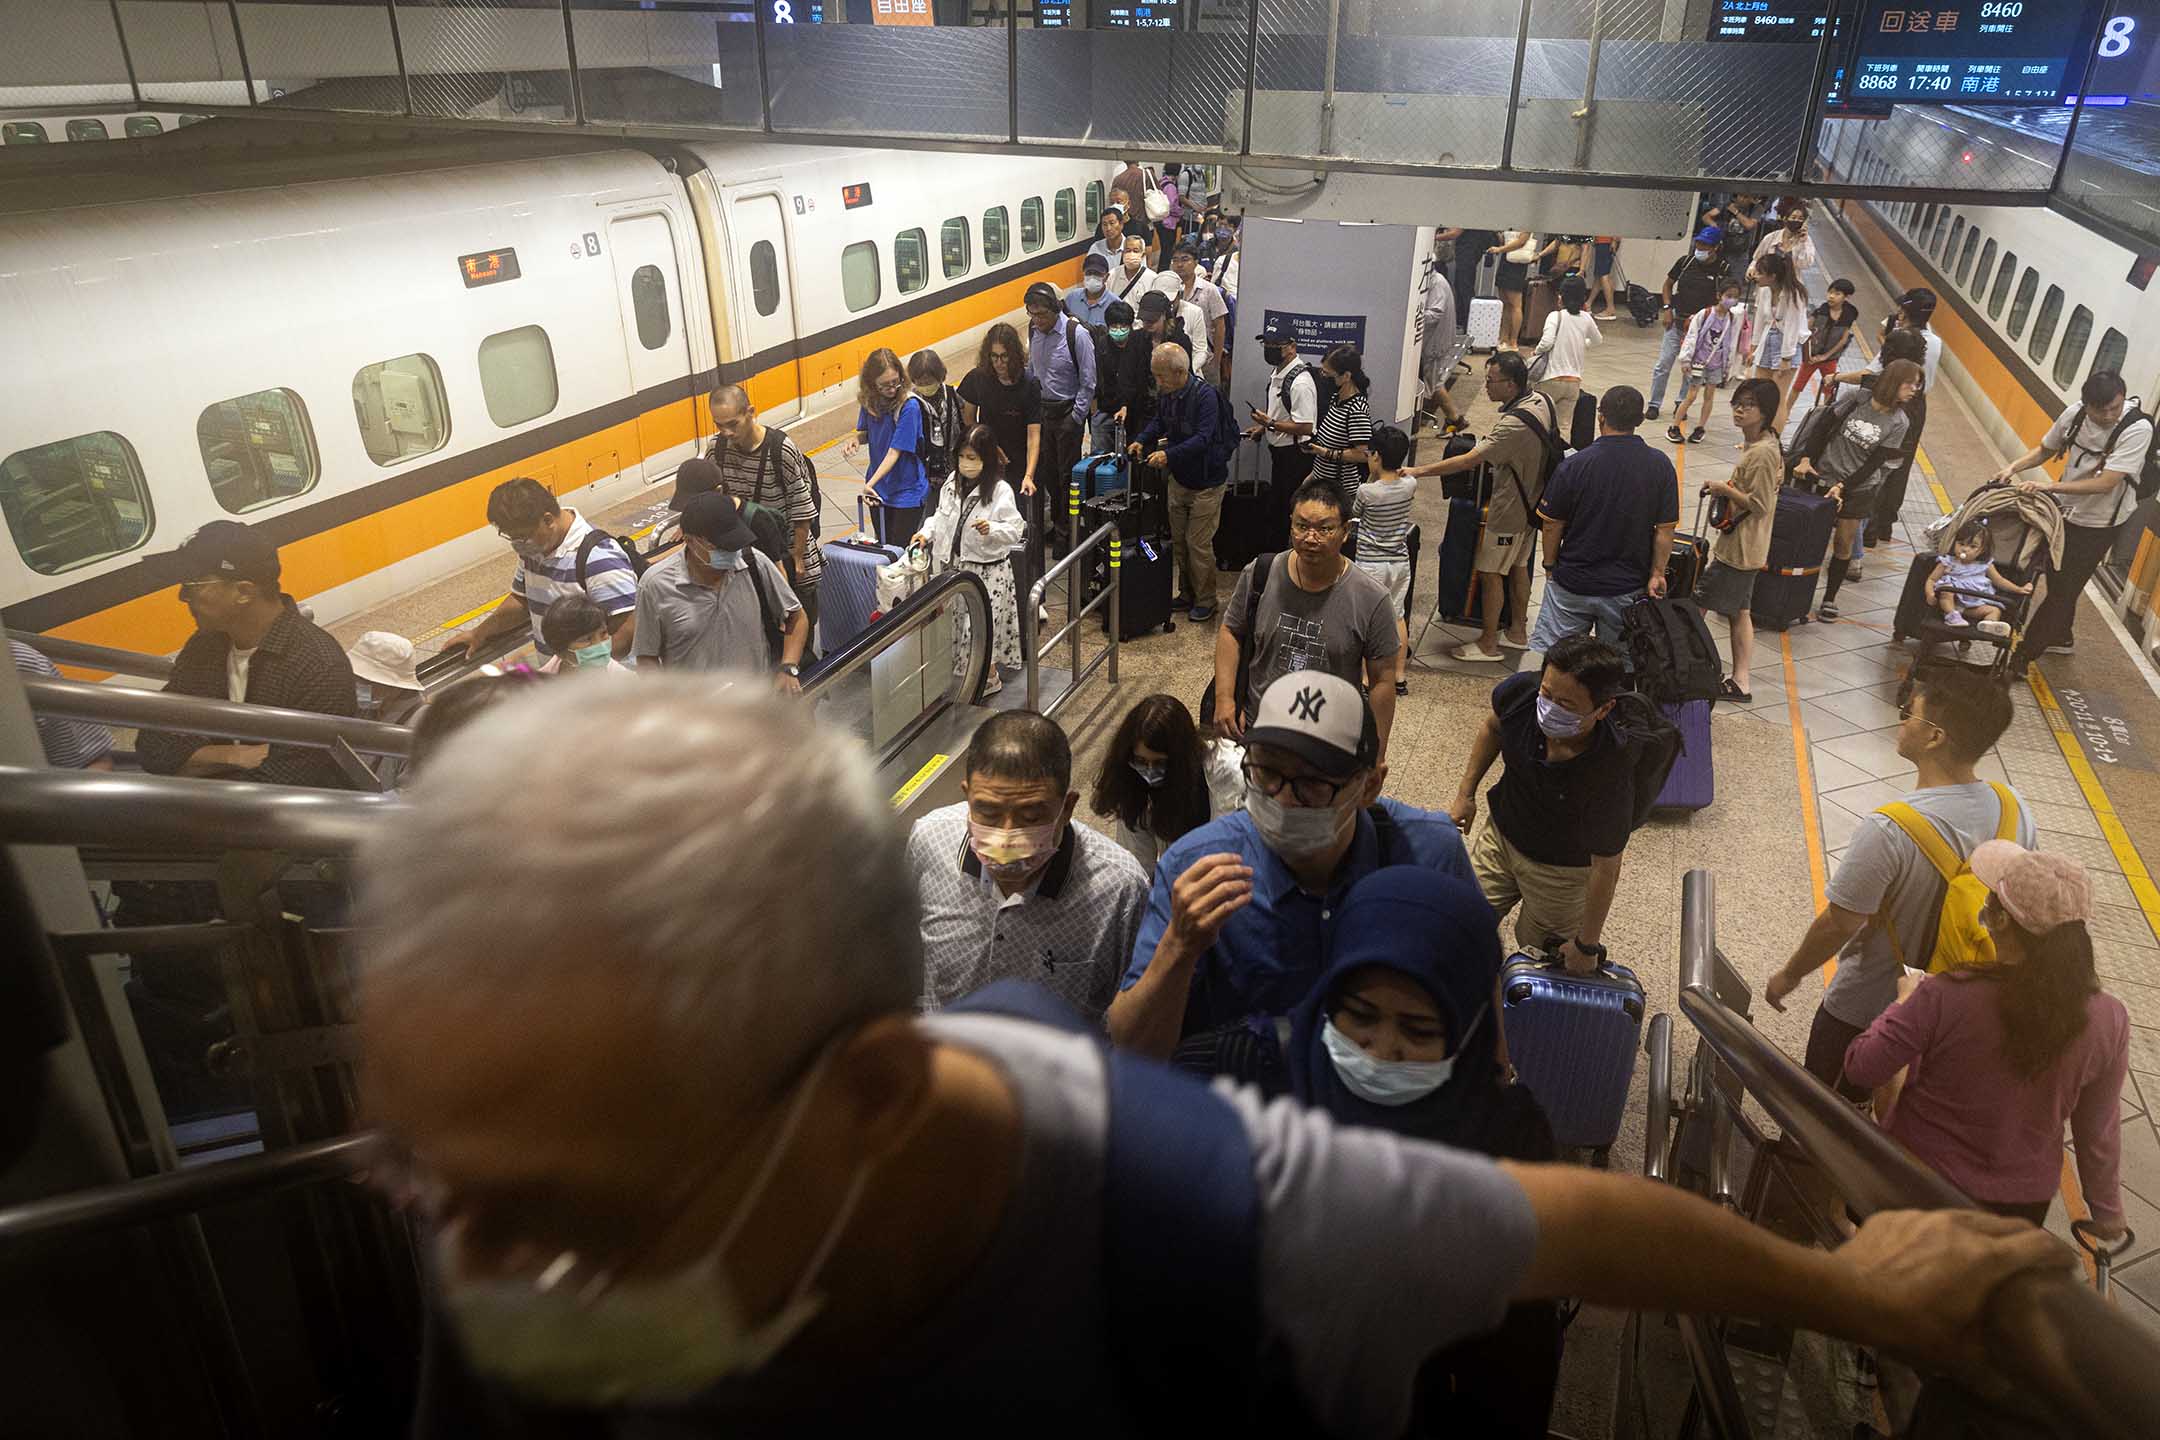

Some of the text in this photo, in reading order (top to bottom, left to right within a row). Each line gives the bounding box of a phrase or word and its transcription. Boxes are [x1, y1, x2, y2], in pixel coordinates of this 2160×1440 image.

[774, 0, 794, 23] 8
[1981, 2, 2023, 18] 8460
[1754, 15, 1777, 25] 8460
[1879, 10, 1960, 33] 回送車
[2098, 16, 2135, 57] 8
[1866, 63, 2048, 74] 下班列車 開車時間 列車開往 自由座
[1859, 75, 1898, 90] 8868
[1908, 76, 1952, 91] 17:40
[1960, 76, 2000, 93] 南港
[795, 198, 803, 213] 9
[587, 235, 598, 254] 8
[1288, 686, 1327, 723] NY
